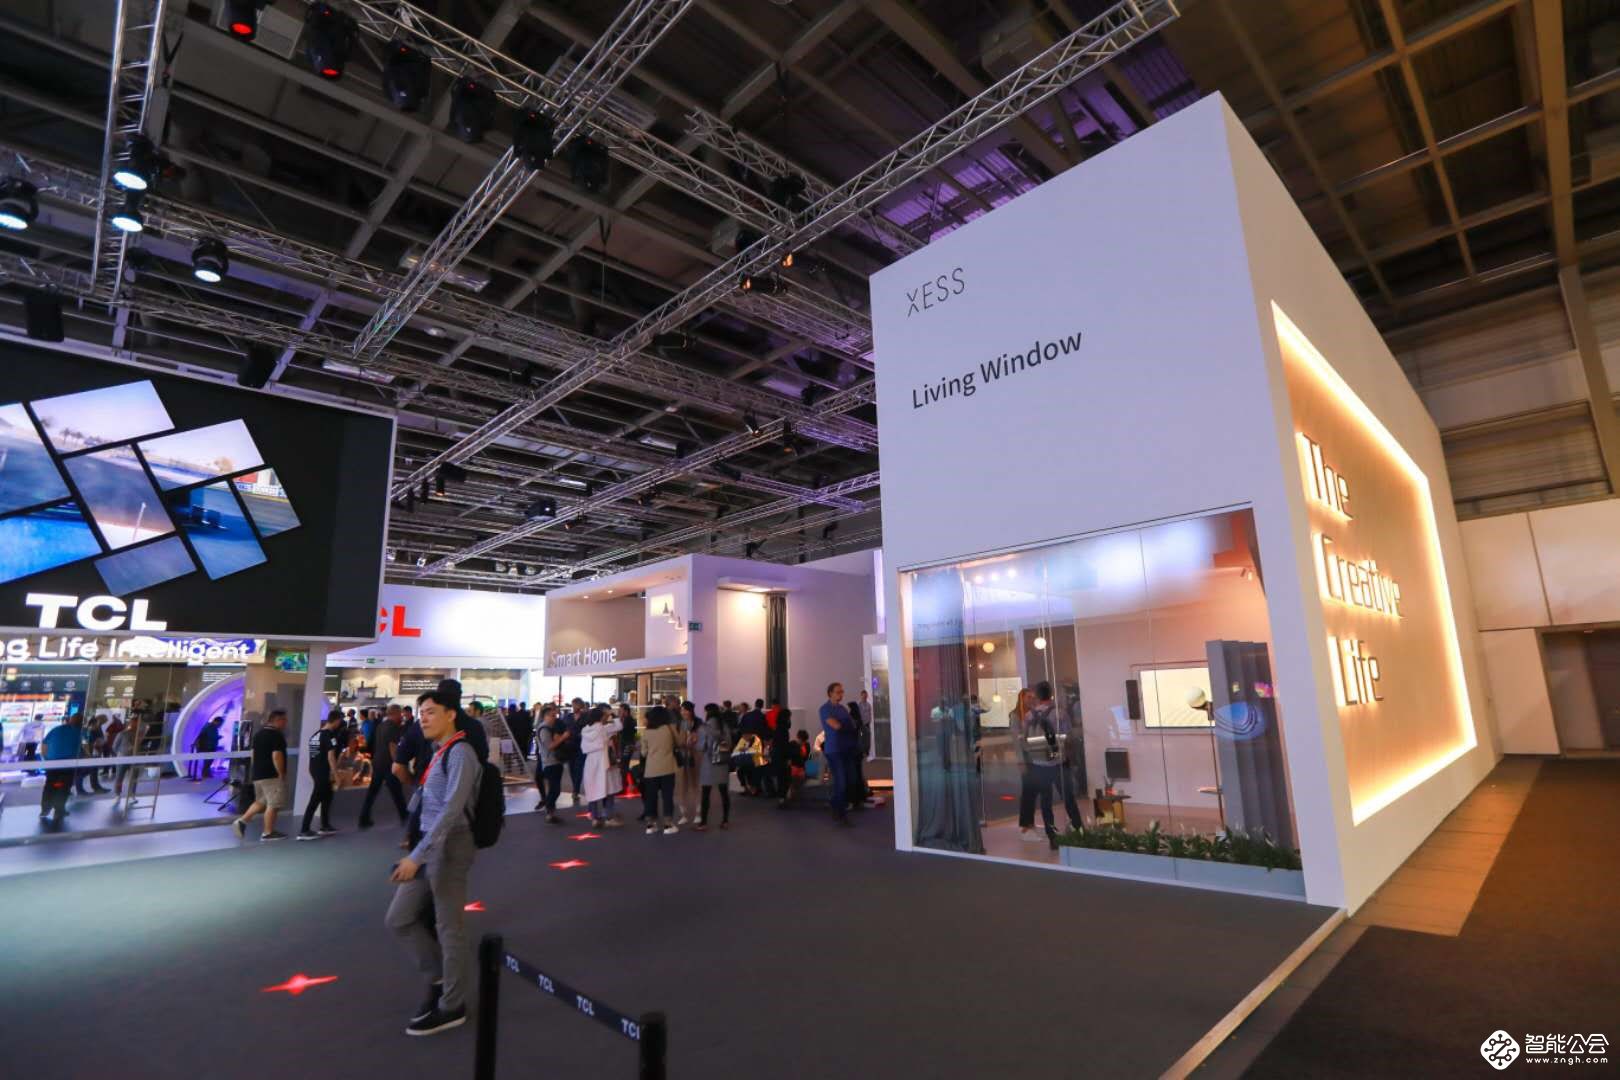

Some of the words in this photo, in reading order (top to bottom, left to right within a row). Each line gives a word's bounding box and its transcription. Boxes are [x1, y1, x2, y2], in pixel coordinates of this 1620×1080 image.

[906, 267, 966, 318] XESS
[912, 371, 977, 410] Living
[980, 331, 1083, 384] Window
[1311, 532, 1405, 619] Creative
[25, 592, 168, 632] TCL
[38, 636, 99, 659] Life
[551, 648, 581, 668] Smart
[583, 646, 617, 666] Home
[1327, 635, 1384, 707] Life
[505, 955, 520, 973] TCL
[538, 974, 555, 993] TCL
[576, 995, 595, 1016] TCL
